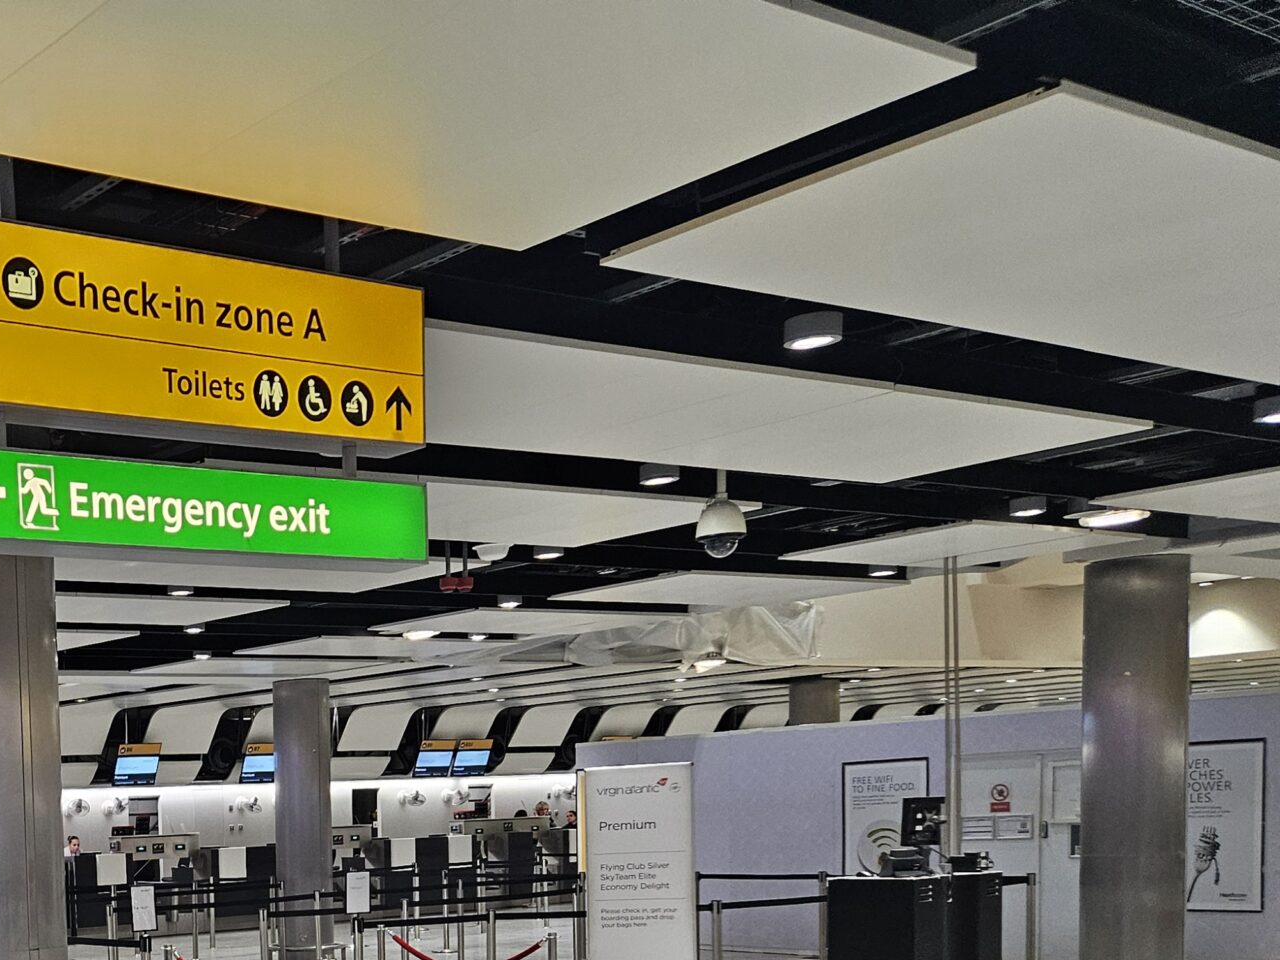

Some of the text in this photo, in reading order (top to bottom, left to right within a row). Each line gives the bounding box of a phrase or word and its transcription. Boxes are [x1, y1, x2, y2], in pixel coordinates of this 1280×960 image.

[53, 270, 327, 342] Check-in zone A
[162, 367, 245, 401] Toilets
[69, 481, 331, 538] Emergency exit
[852, 776, 872, 785] FREE
[852, 785, 864, 793] TO
[867, 784, 886, 792] FINE
[599, 819, 657, 832] Premium
[600, 863, 625, 872] Flying
[600, 872, 657, 882] SkyTeam Elite
[600, 882, 670, 892] Economy Delight
